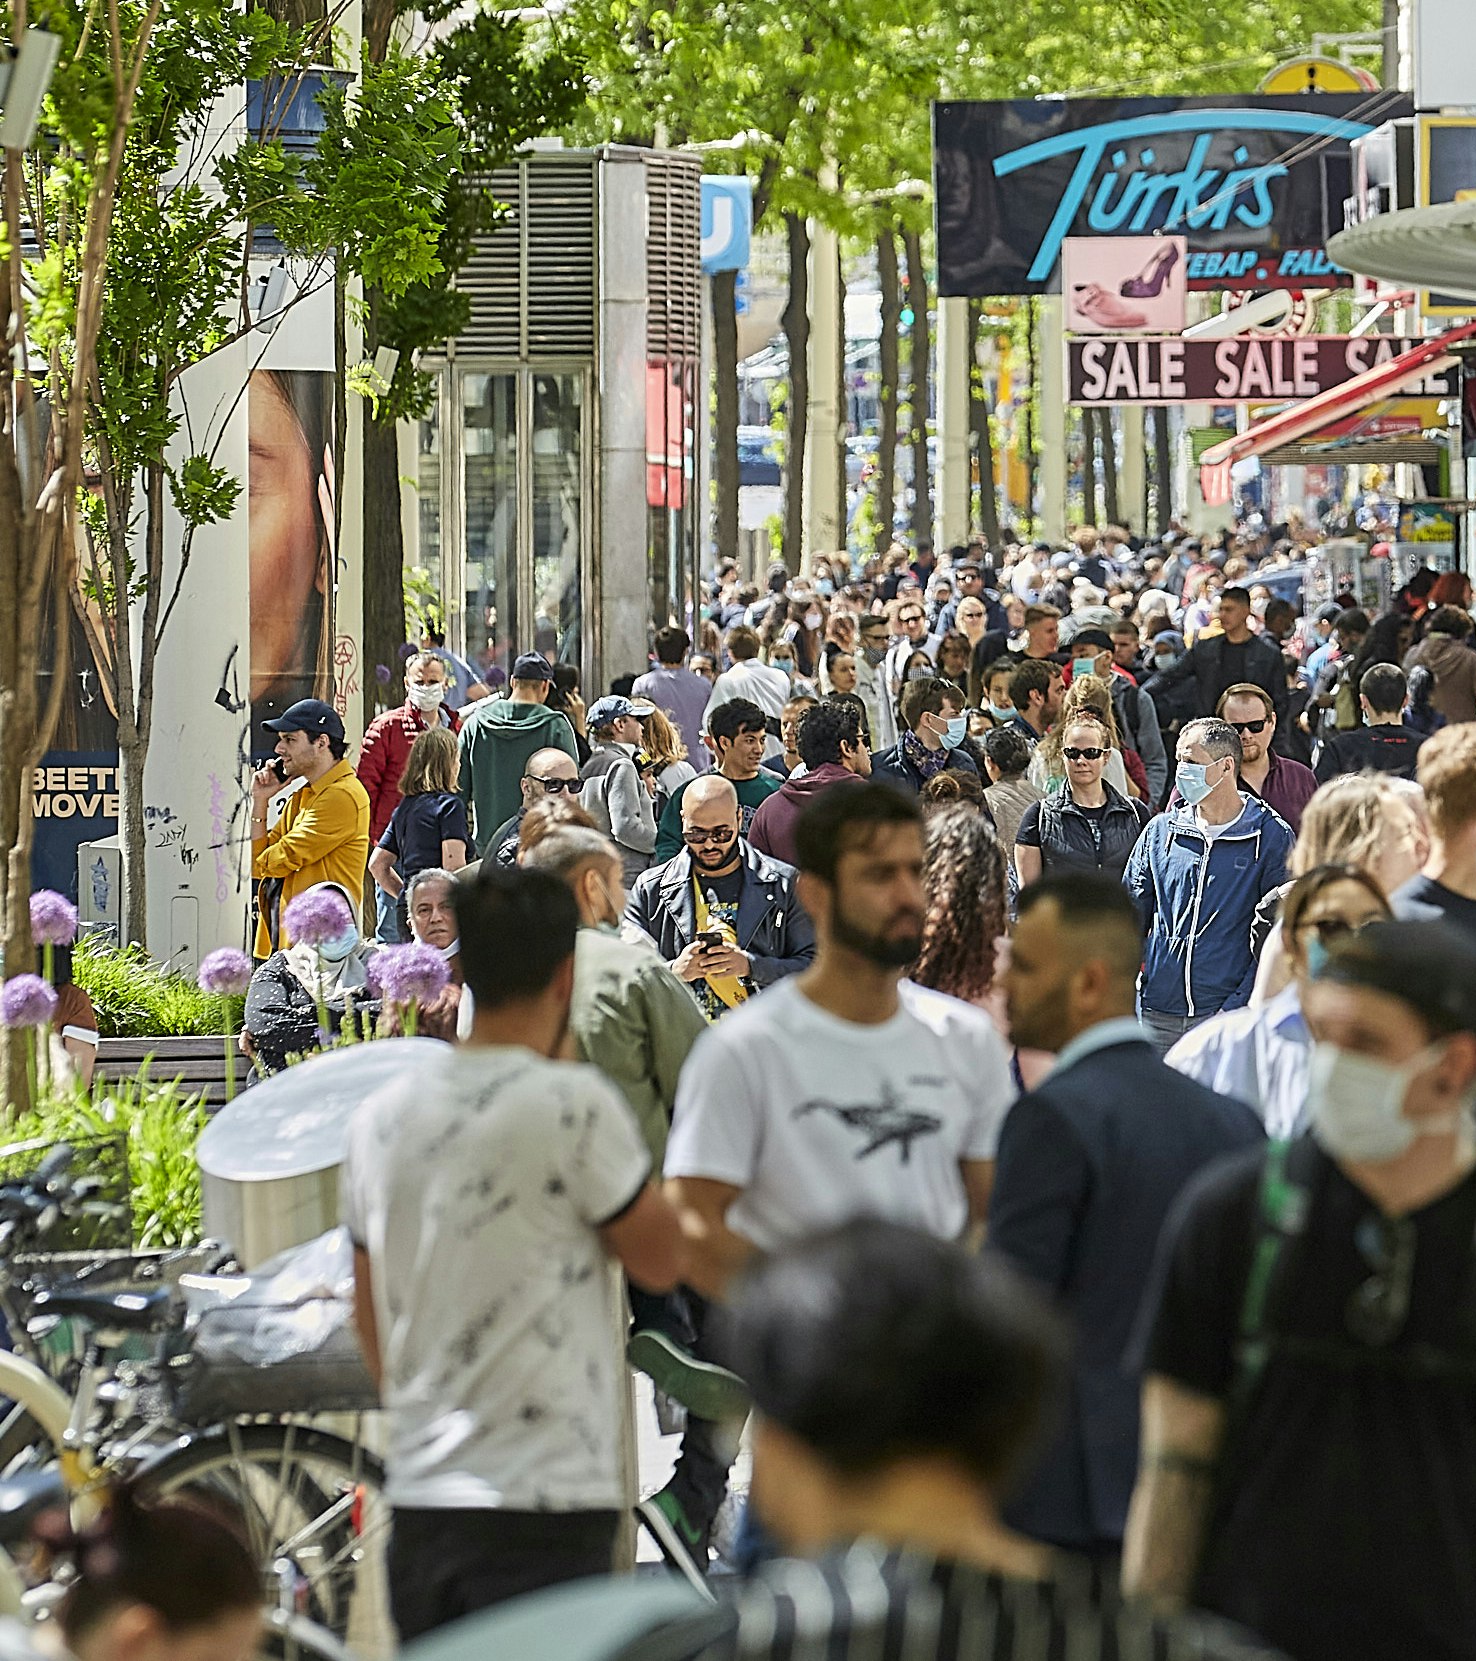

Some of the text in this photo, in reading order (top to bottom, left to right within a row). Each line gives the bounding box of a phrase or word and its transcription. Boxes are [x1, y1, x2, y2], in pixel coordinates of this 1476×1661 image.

[992, 108, 1376, 282] Türkis
[1185, 250, 1259, 279] EBAP
[1080, 341, 1187, 398] SALE
[1215, 341, 1320, 398] SALE
